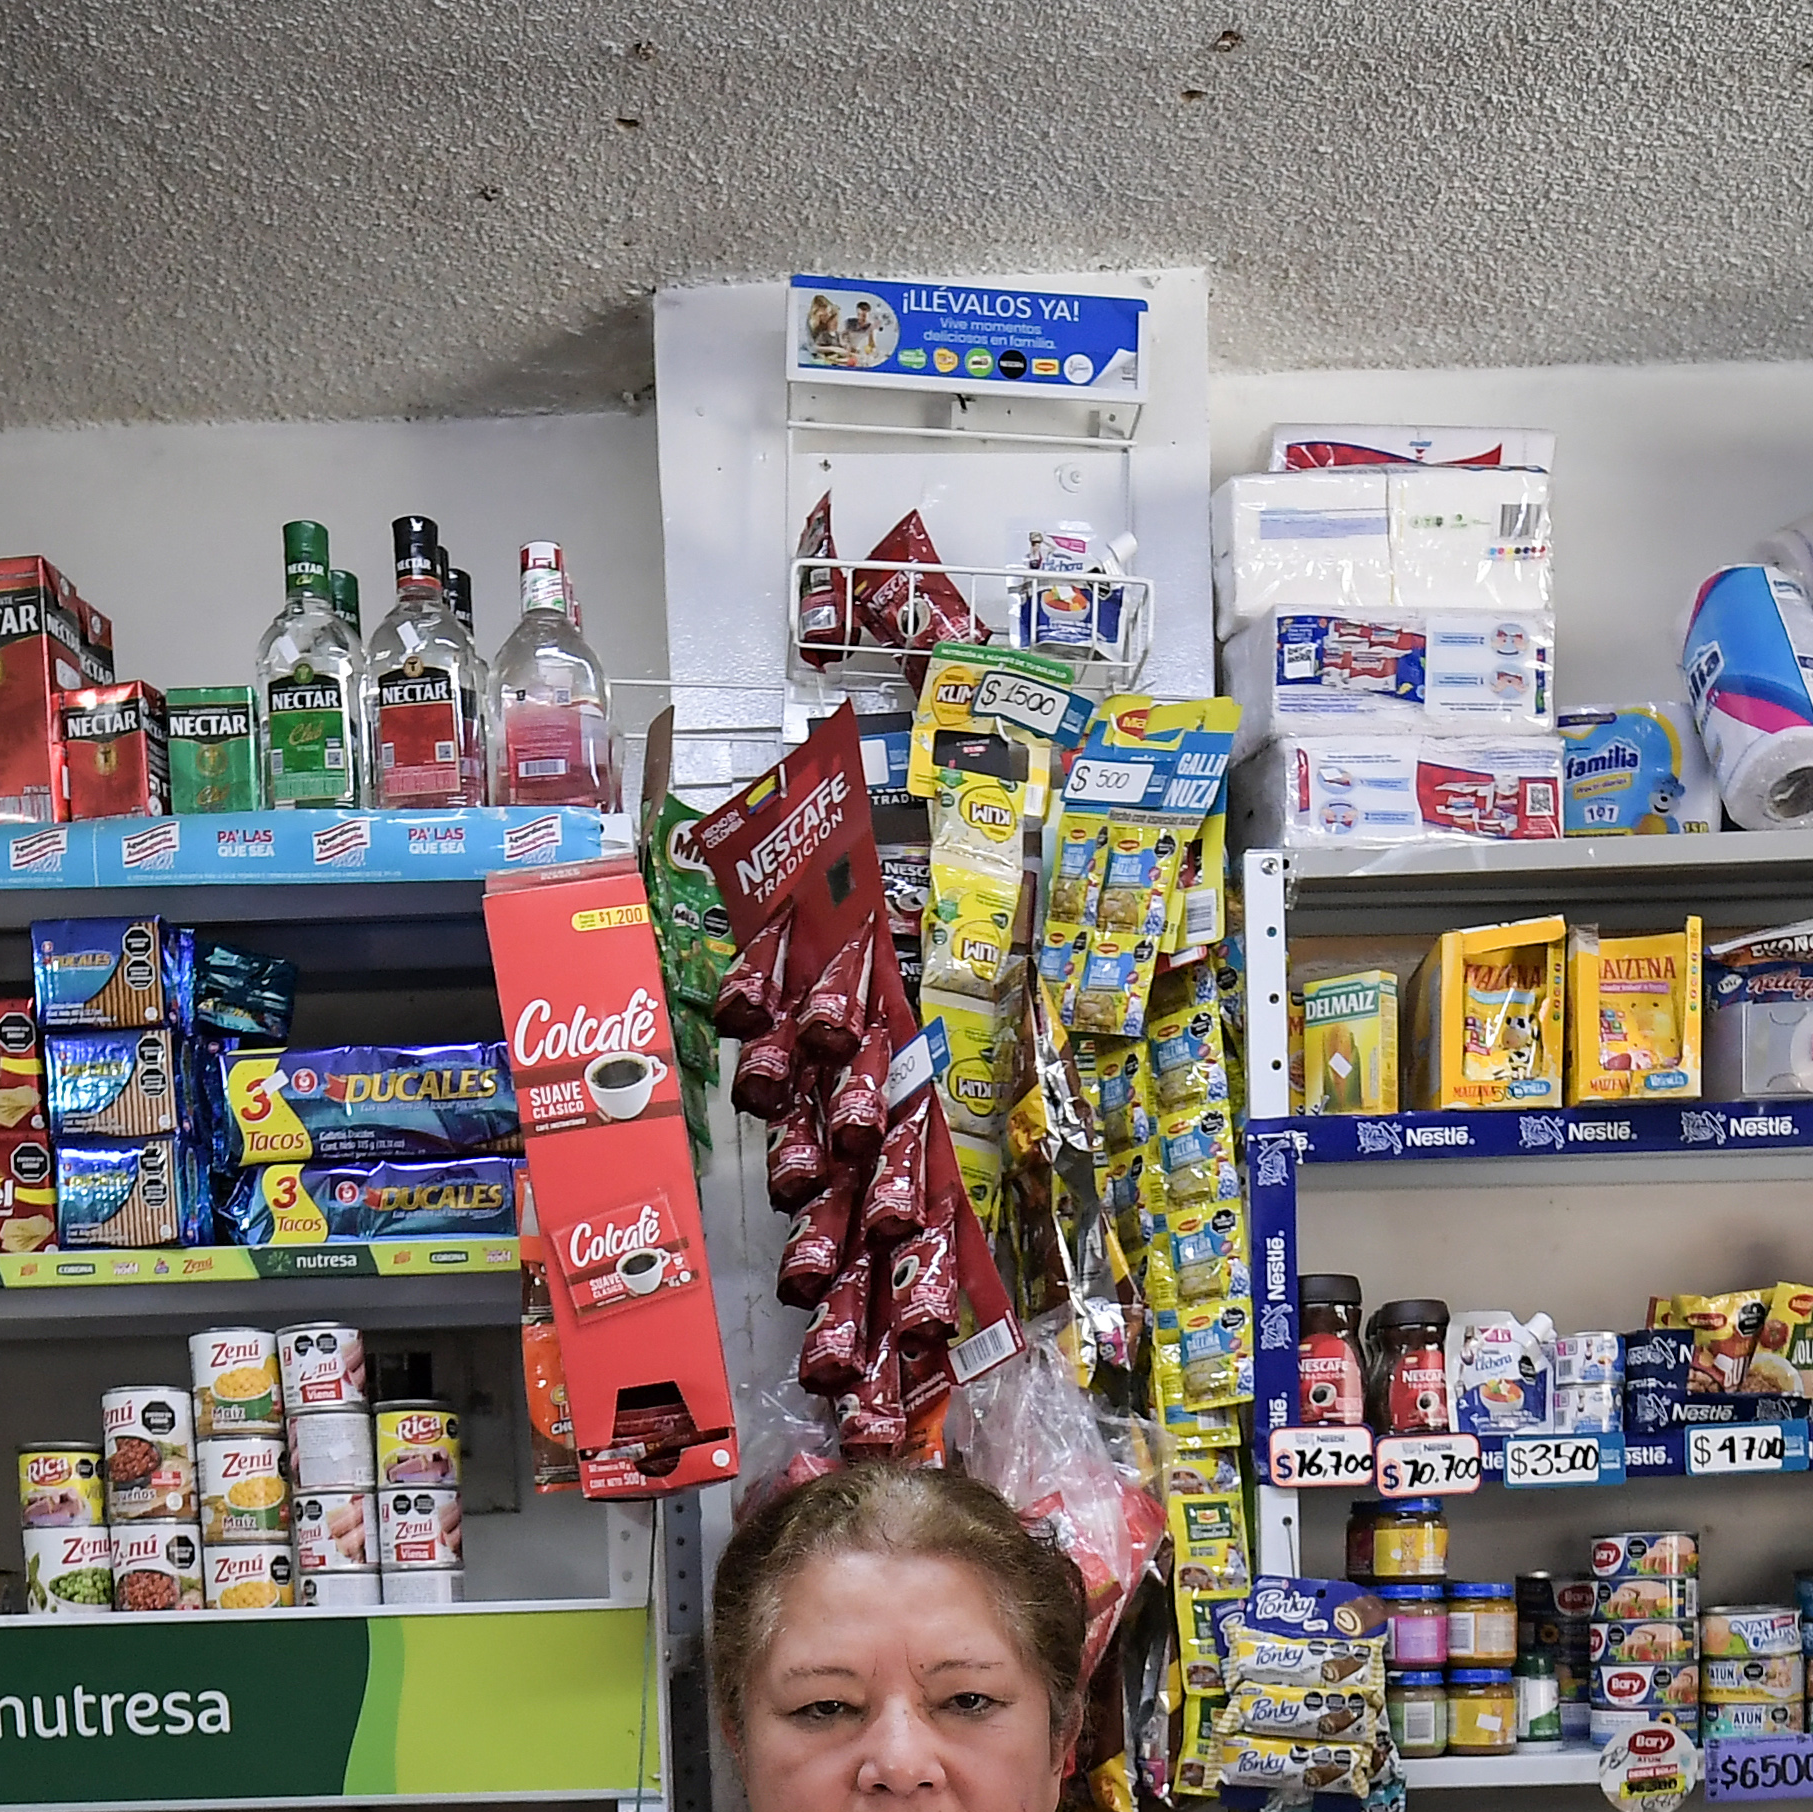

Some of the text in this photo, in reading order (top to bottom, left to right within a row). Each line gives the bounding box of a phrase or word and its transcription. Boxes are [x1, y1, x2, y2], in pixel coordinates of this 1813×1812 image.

[902, 287, 1080, 322] ¡LLÉVALOS YA!
[940, 317, 1042, 335] Vive momentos
[923, 329, 988, 347] deliciosos
[990, 336, 1006, 347] en
[288, 562, 324, 575] NECTAR
[397, 558, 431, 571] NECTAR
[381, 681, 448, 703] NECTAR
[937, 684, 974, 703] KLIM
[1002, 678, 1056, 715] 1500
[1567, 752, 1639, 779] familia
[1097, 771, 1129, 789] 500
[970, 803, 1011, 826] KLIM
[243, 829, 273, 843] LAS
[217, 843, 275, 857] QUE SEA
[754, 808, 842, 904] TRADICIÓN
[598, 907, 643, 927] $1.200
[1305, 990, 1375, 1021] DELMAIZ
[514, 989, 658, 1066] Colcafé
[345, 1069, 498, 1102] DUCALES
[529, 1081, 583, 1107] SUAVE
[241, 1078, 273, 1122] 3
[246, 1130, 304, 1150] Tacos
[273, 1177, 297, 1209] 3
[381, 1184, 502, 1209] DUCALES
[277, 1216, 321, 1231] Tacos
[571, 1207, 660, 1267] Colcafé
[296, 1254, 357, 1268] nutresa
[211, 1341, 258, 1366] Zenú
[397, 1416, 440, 1438] Rica
[223, 1451, 273, 1478] Zenú
[395, 1520, 433, 1539] Zenú
[1257, 1591, 1317, 1620] Ponky
[1609, 1675, 1643, 1694] Bary
[1634, 1732, 1670, 1754] Bary
